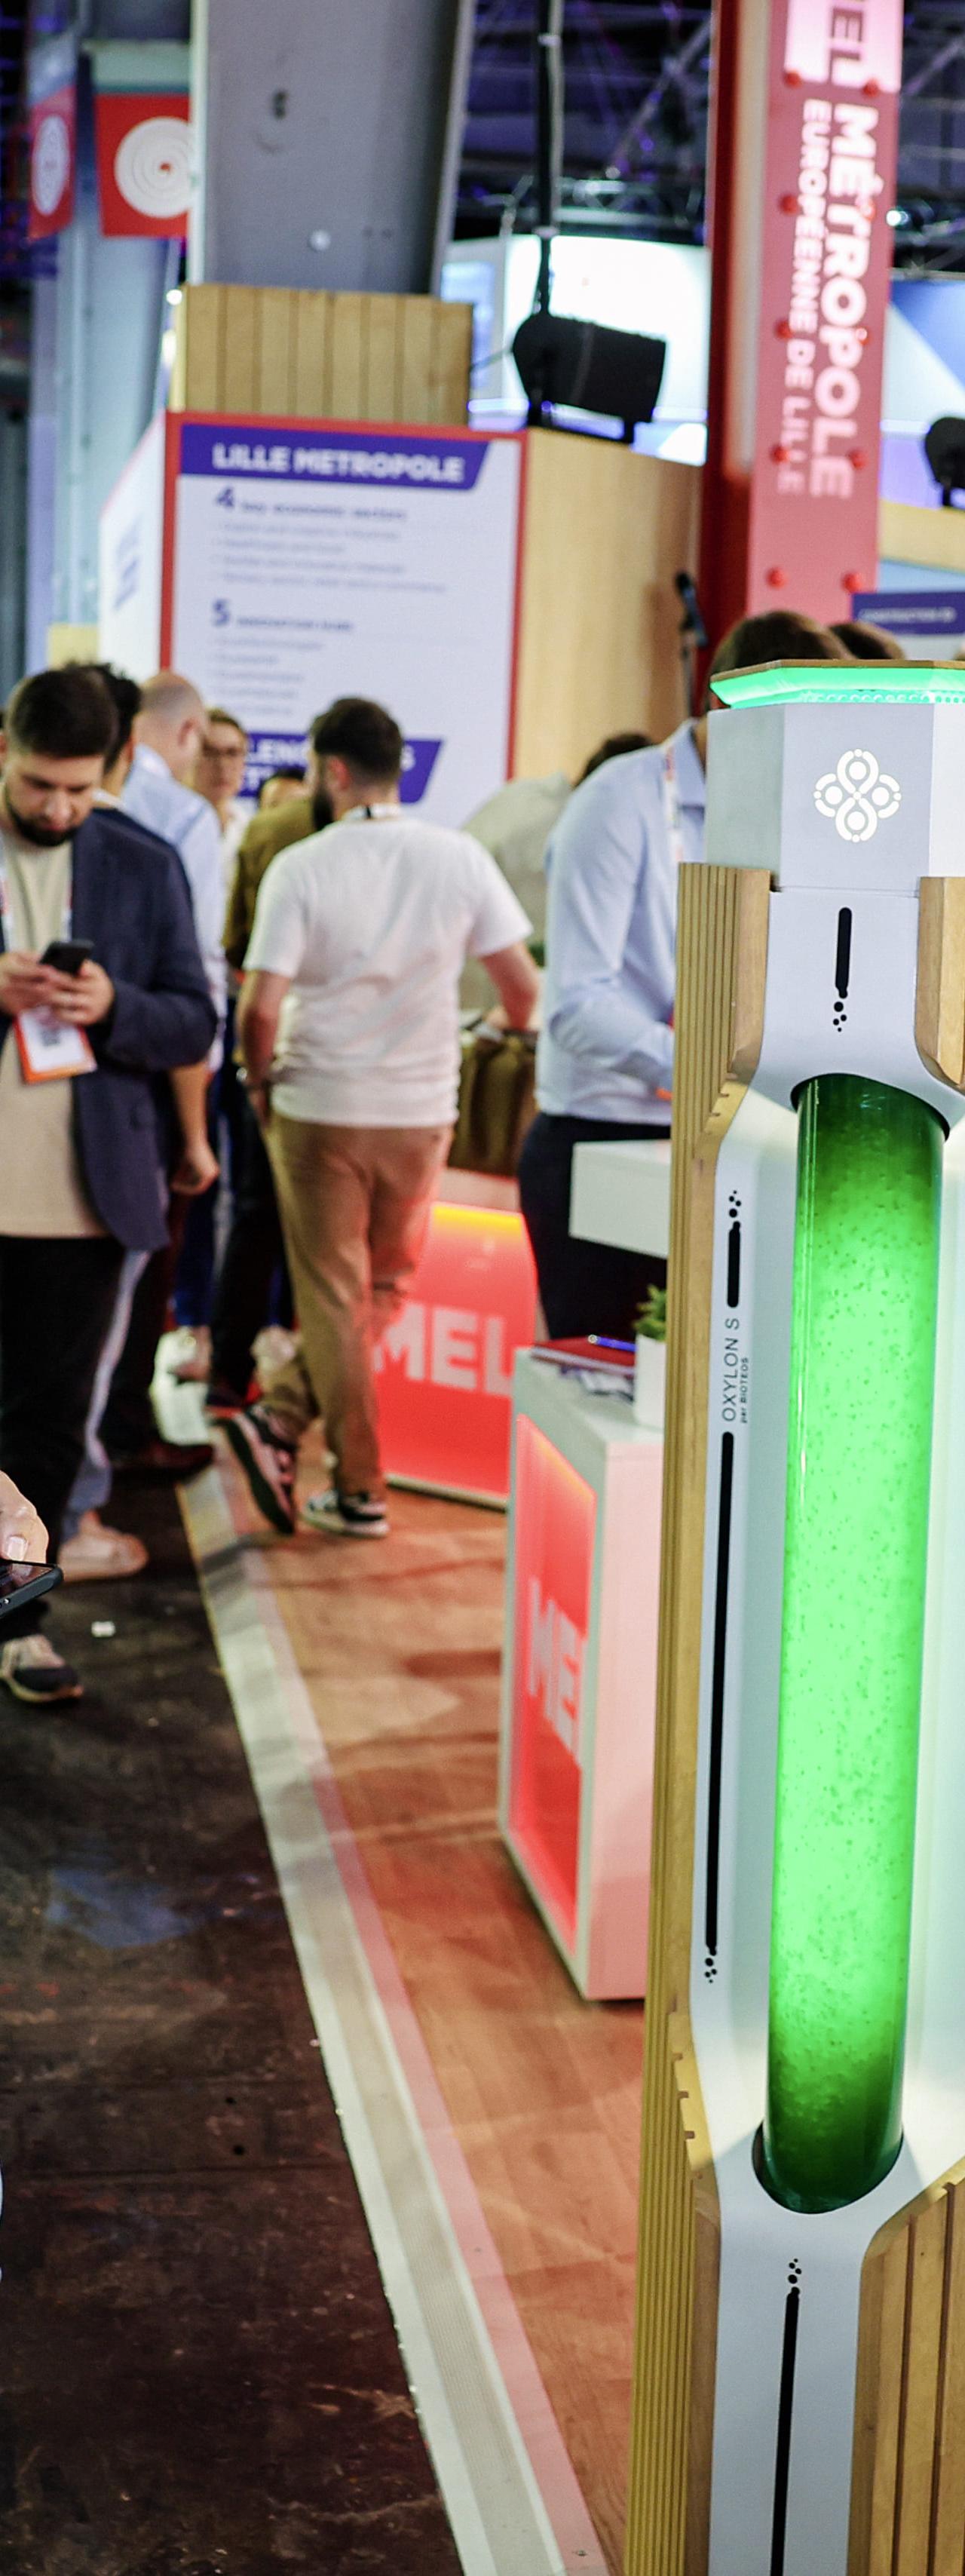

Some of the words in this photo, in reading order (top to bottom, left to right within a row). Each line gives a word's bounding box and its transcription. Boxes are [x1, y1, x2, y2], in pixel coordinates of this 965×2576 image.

[828, 0, 864, 84] EL
[810, 103, 884, 499] MÉTROPOLE
[784, 338, 816, 390] DE
[212, 442, 293, 473] LILLE
[777, 396, 813, 494] LILLE
[215, 488, 235, 509] 4
[211, 600, 230, 627] 5
[725, 1317, 740, 1330] S
[721, 1337, 738, 1421] OXYLON
[740, 1357, 749, 1403] BIOTEOS
